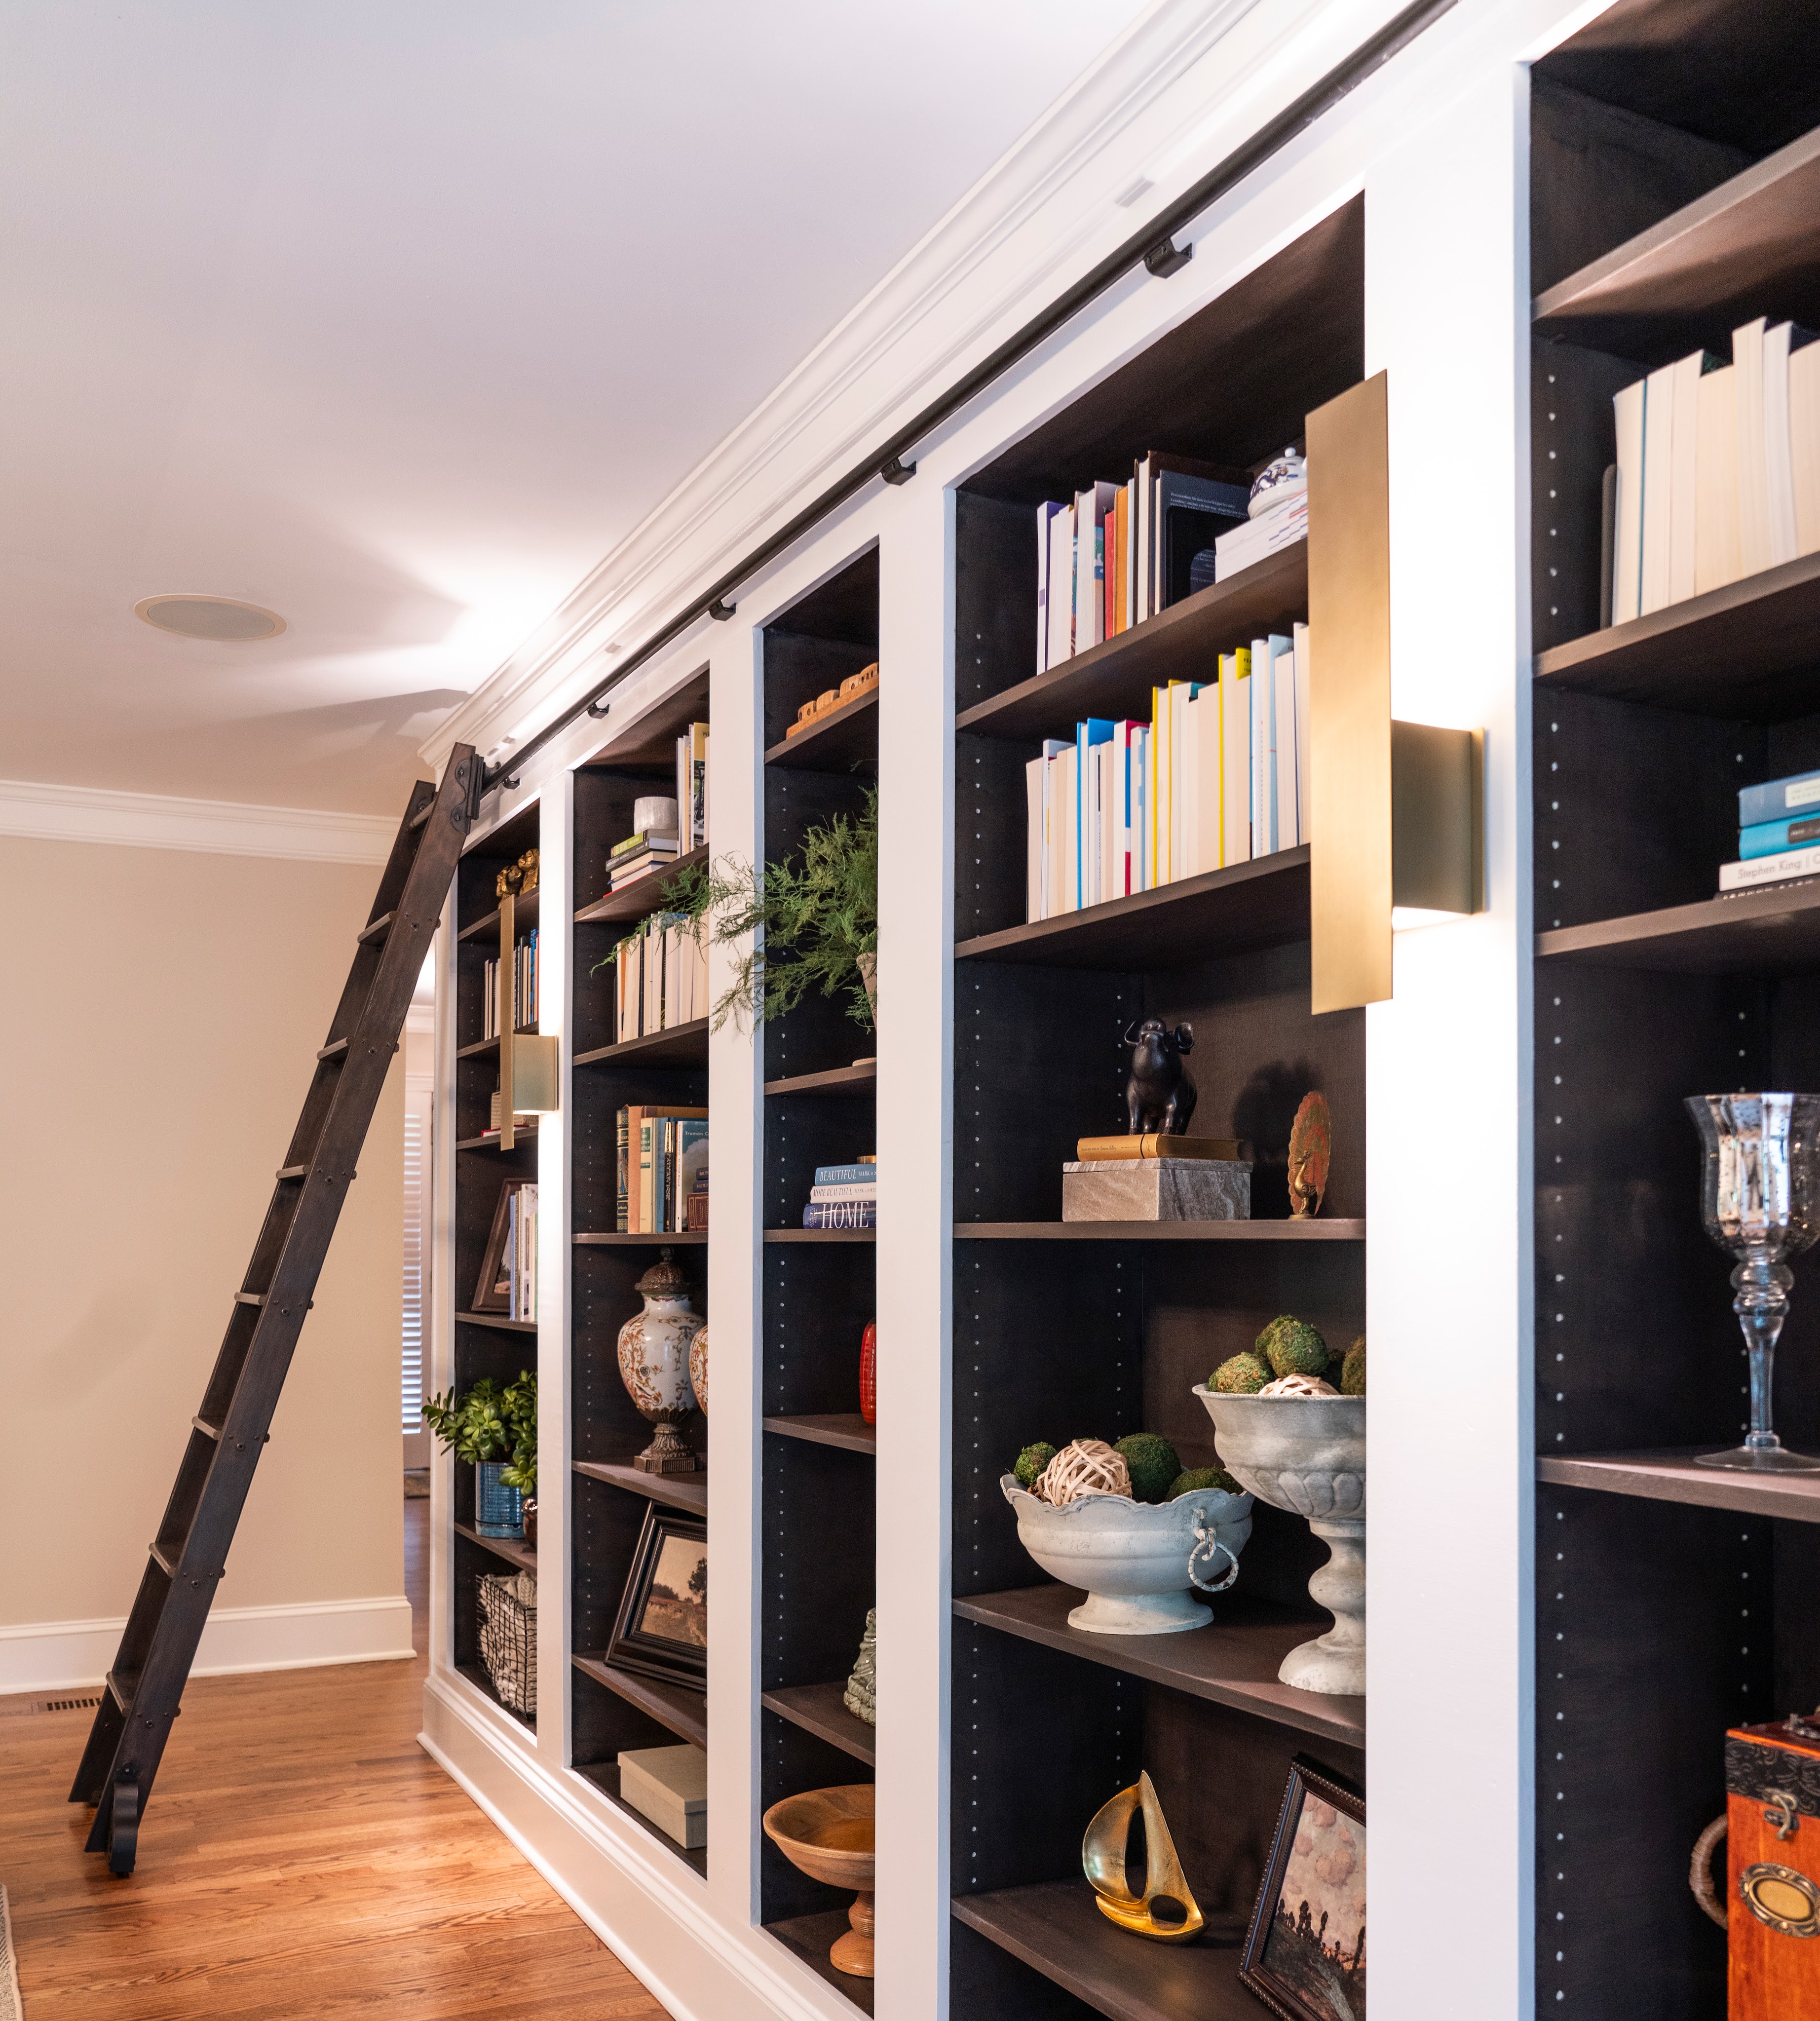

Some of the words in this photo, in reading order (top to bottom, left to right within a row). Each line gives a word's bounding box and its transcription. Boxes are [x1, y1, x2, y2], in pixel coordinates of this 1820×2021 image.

[1738, 865, 1775, 879] Stephen
[1779, 859, 1802, 871] King
[820, 1169, 857, 1182] BEAUTIFUL
[813, 1188, 826, 1197] MORE
[827, 1187, 853, 1197] BEAUTIFUL
[821, 1201, 870, 1229] HOME
